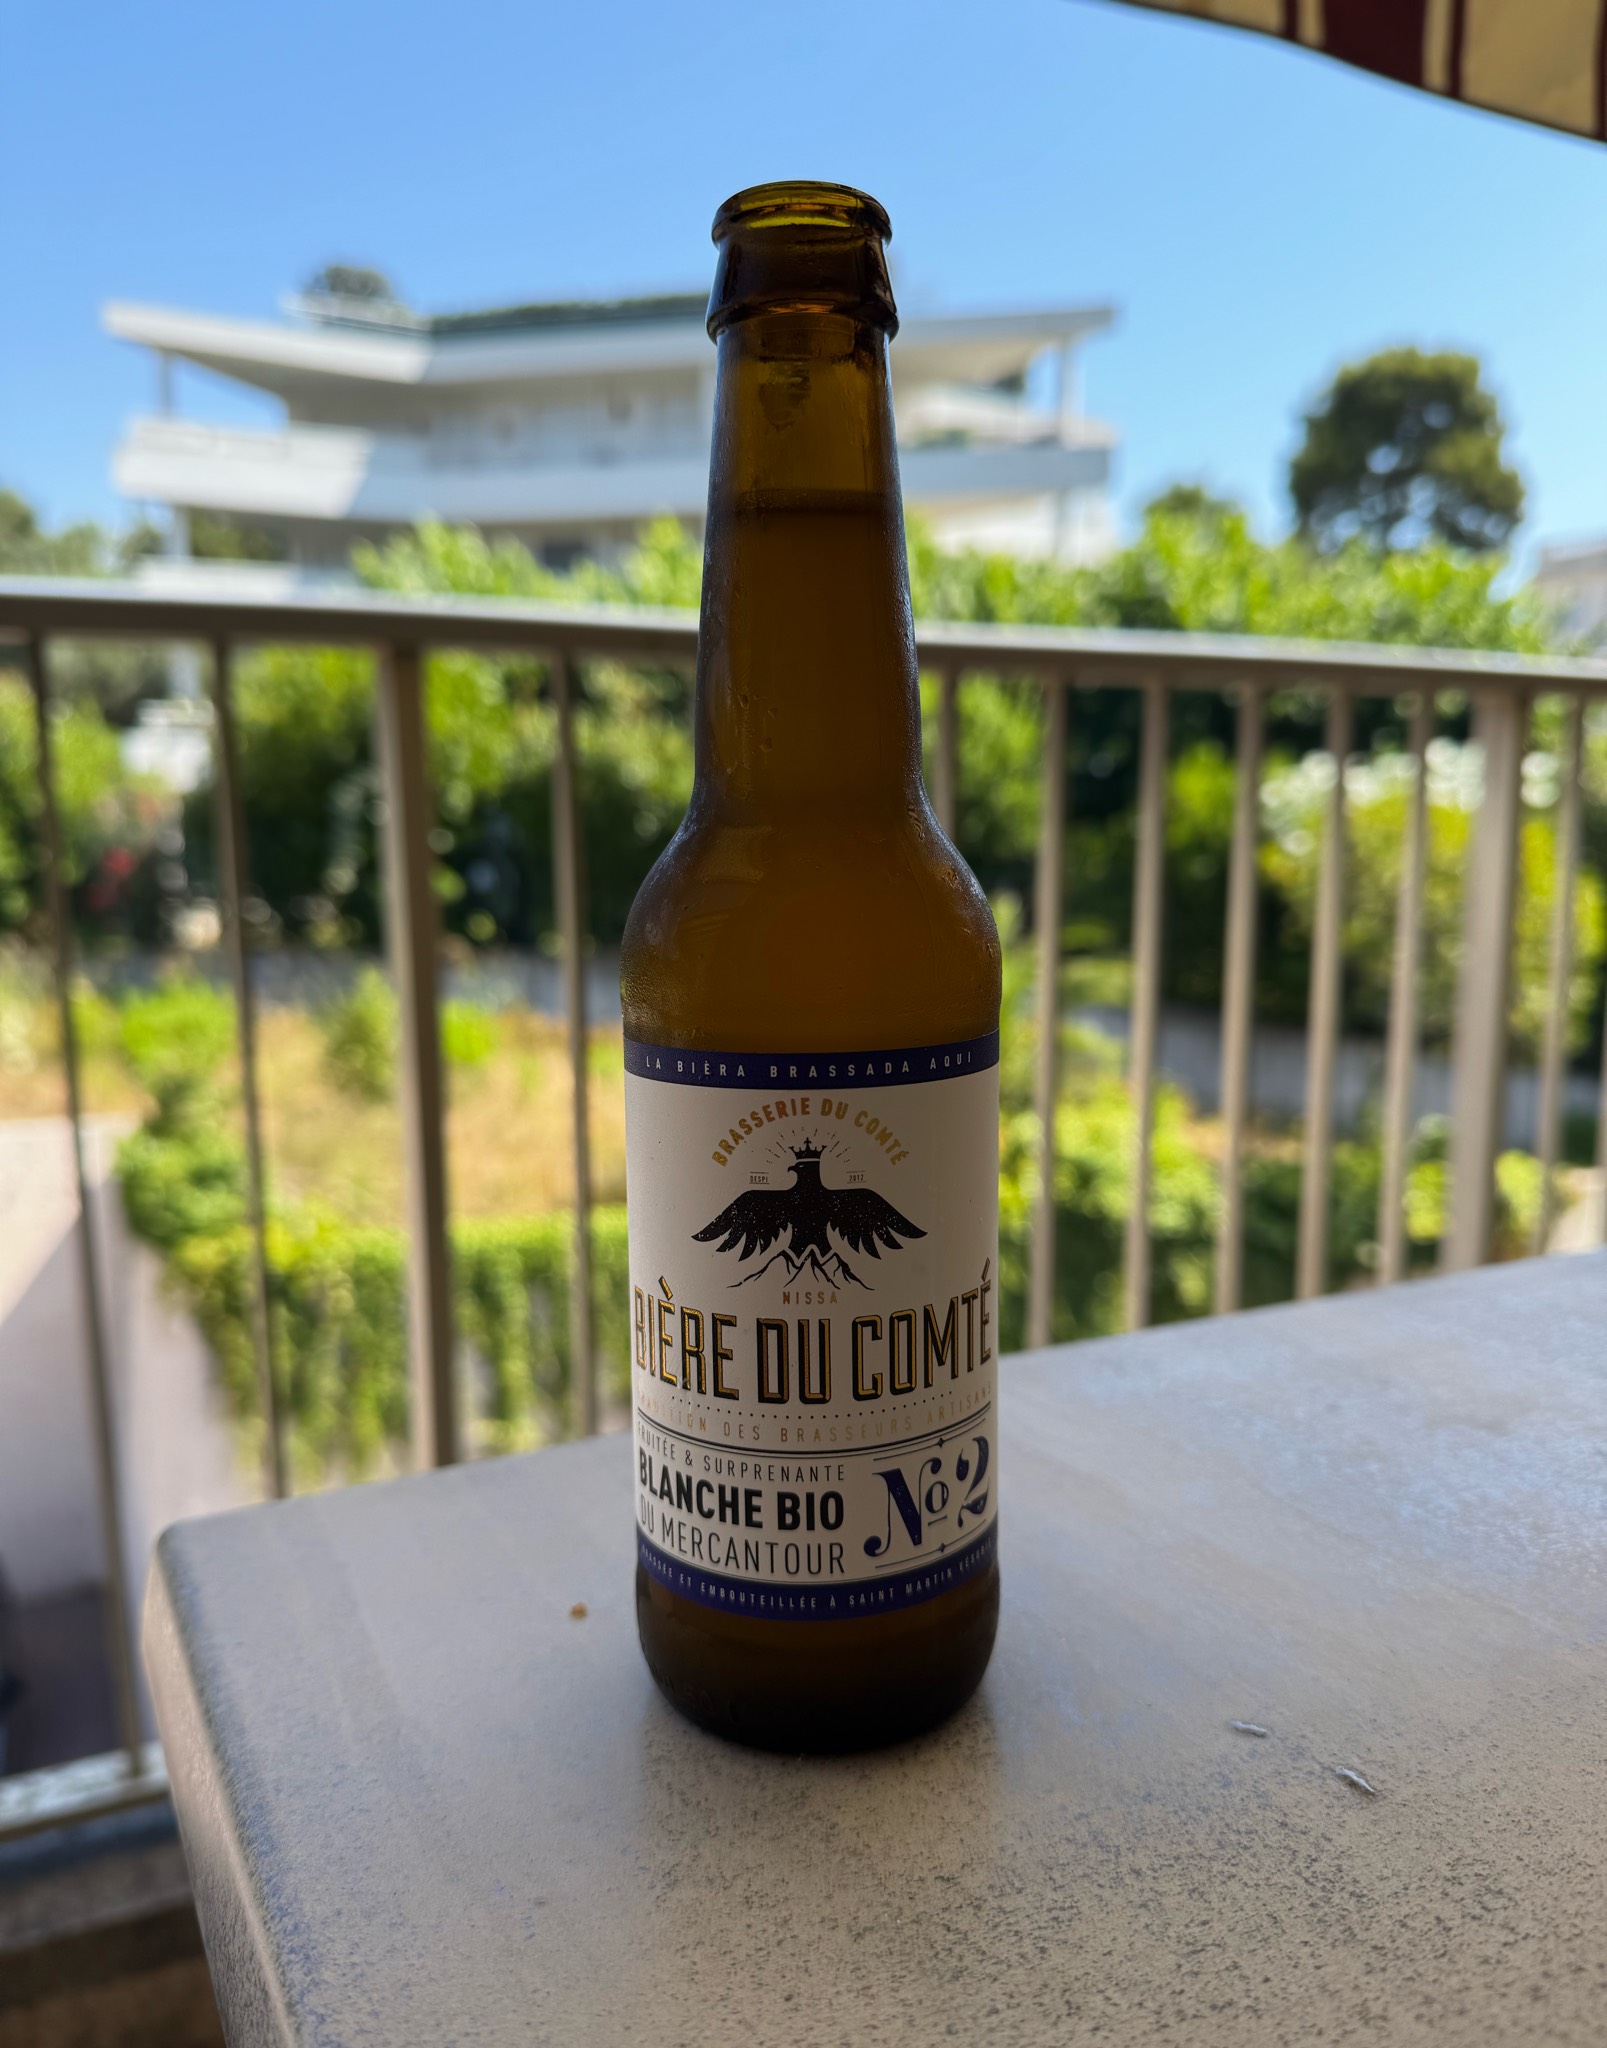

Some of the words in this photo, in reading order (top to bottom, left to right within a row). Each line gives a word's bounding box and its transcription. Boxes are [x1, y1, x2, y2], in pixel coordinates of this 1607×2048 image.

[645, 1055, 661, 1070] LA
[677, 1060, 745, 1077] BIÈRA
[770, 1061, 910, 1078] BRASSADA
[930, 1051, 972, 1070] AQUI
[711, 1097, 811, 1167] BRASSERIE
[820, 1097, 849, 1120] DU
[854, 1110, 910, 1167] COMTÉ
[782, 1291, 838, 1305] NISSA
[634, 1275, 740, 1401] BIÈRE
[756, 1317, 832, 1405] DU
[851, 1257, 991, 1402] COMTÉ
[723, 1422, 761, 1441] DES
[780, 1416, 912, 1443] BRASSEURS
[684, 1449, 693, 1467] &
[703, 1454, 845, 1483] SURPRENANTE
[638, 1446, 764, 1529] BLANCHE
[776, 1490, 845, 1531] BIO
[640, 1494, 655, 1534] DU
[661, 1512, 846, 1576] MERCANTOUR
[680, 1573, 692, 1588] ET
[701, 1582, 817, 1608] EMBOUTEILLÉE
[849, 1587, 895, 1606] SAINT
[905, 1568, 953, 1596] MARTIN
